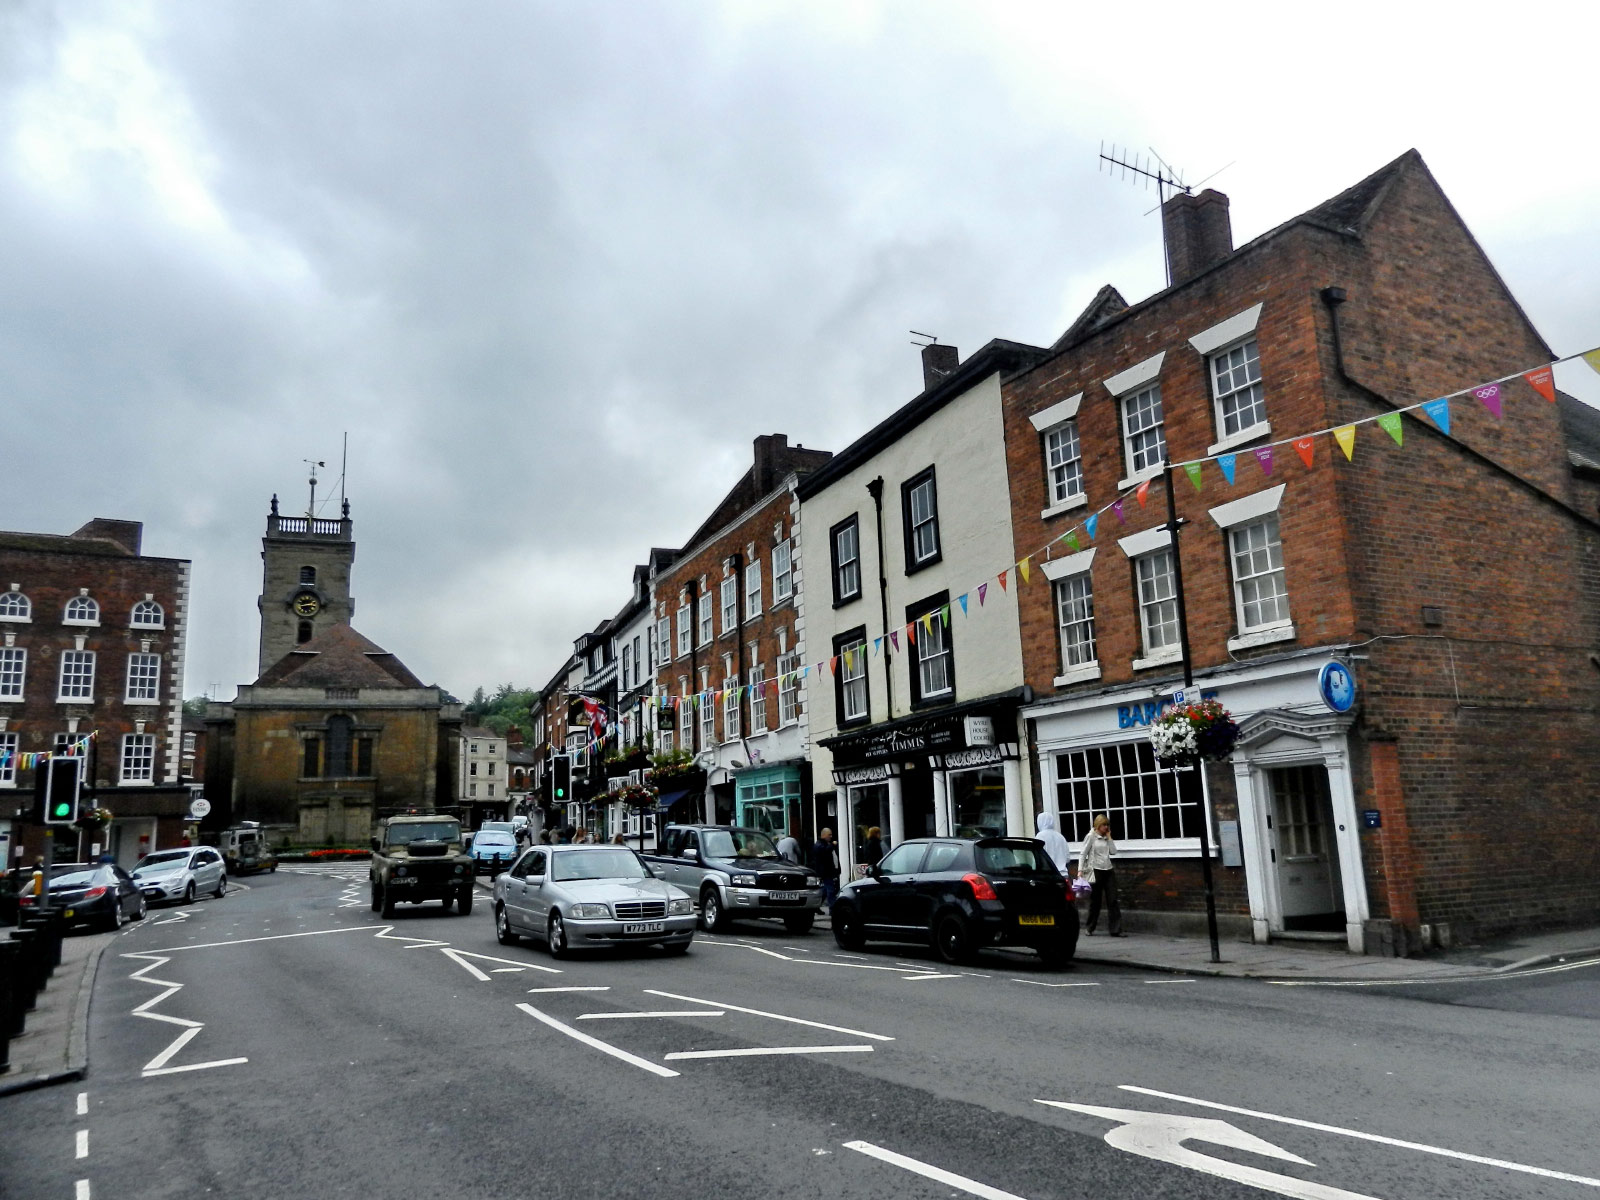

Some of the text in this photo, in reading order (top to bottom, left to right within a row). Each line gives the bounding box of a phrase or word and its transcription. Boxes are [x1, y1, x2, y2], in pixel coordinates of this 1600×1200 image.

[891, 737, 925, 751] TIMMIS
[626, 923, 662, 933] W773 TLC
